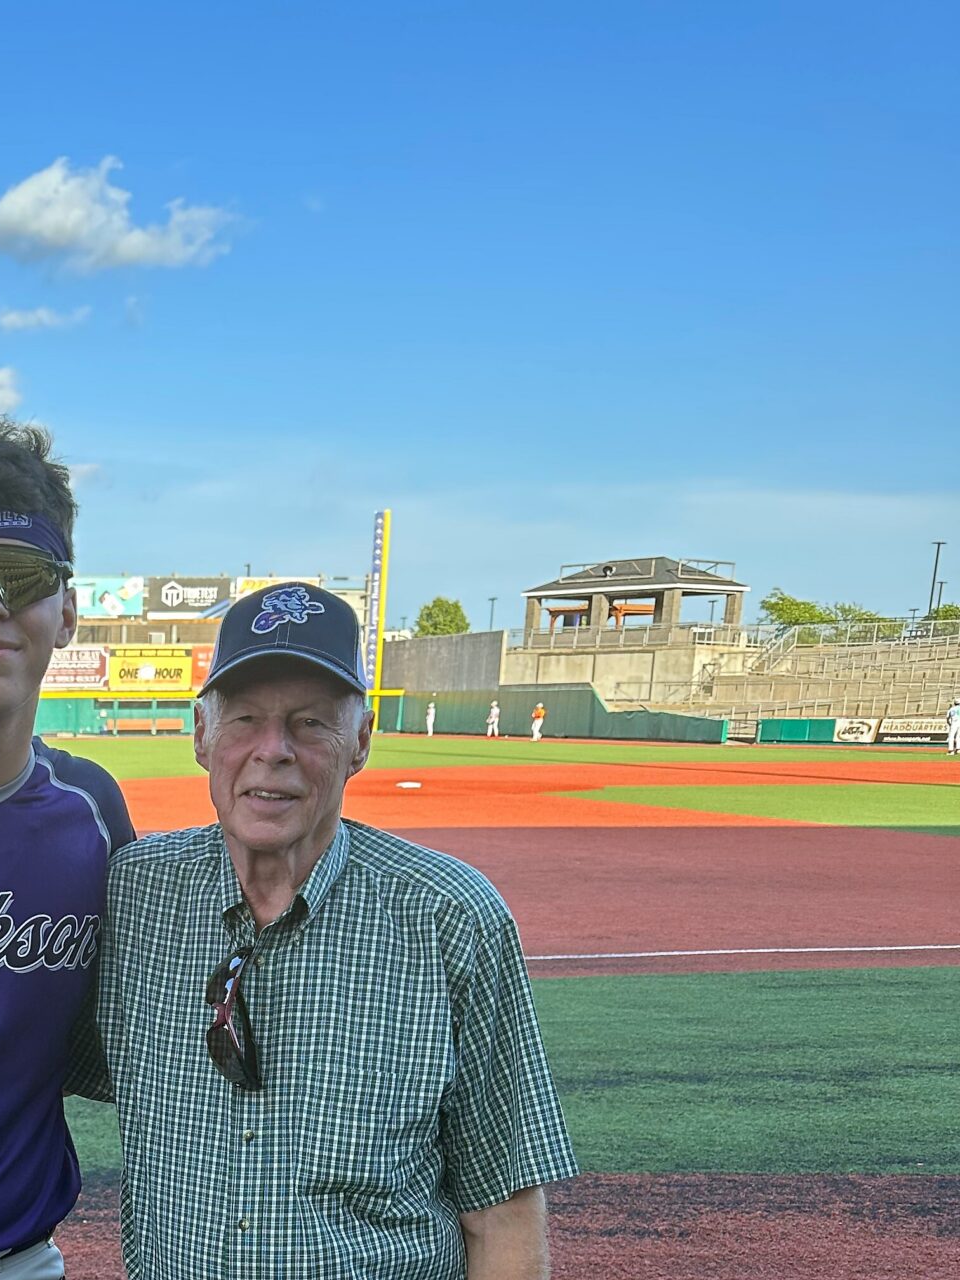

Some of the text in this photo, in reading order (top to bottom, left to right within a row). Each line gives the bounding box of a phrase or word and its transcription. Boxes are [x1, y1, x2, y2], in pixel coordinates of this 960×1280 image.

[119, 668, 183, 679] ONE HOUR
[883, 722, 948, 732] HEADQUARTERS
